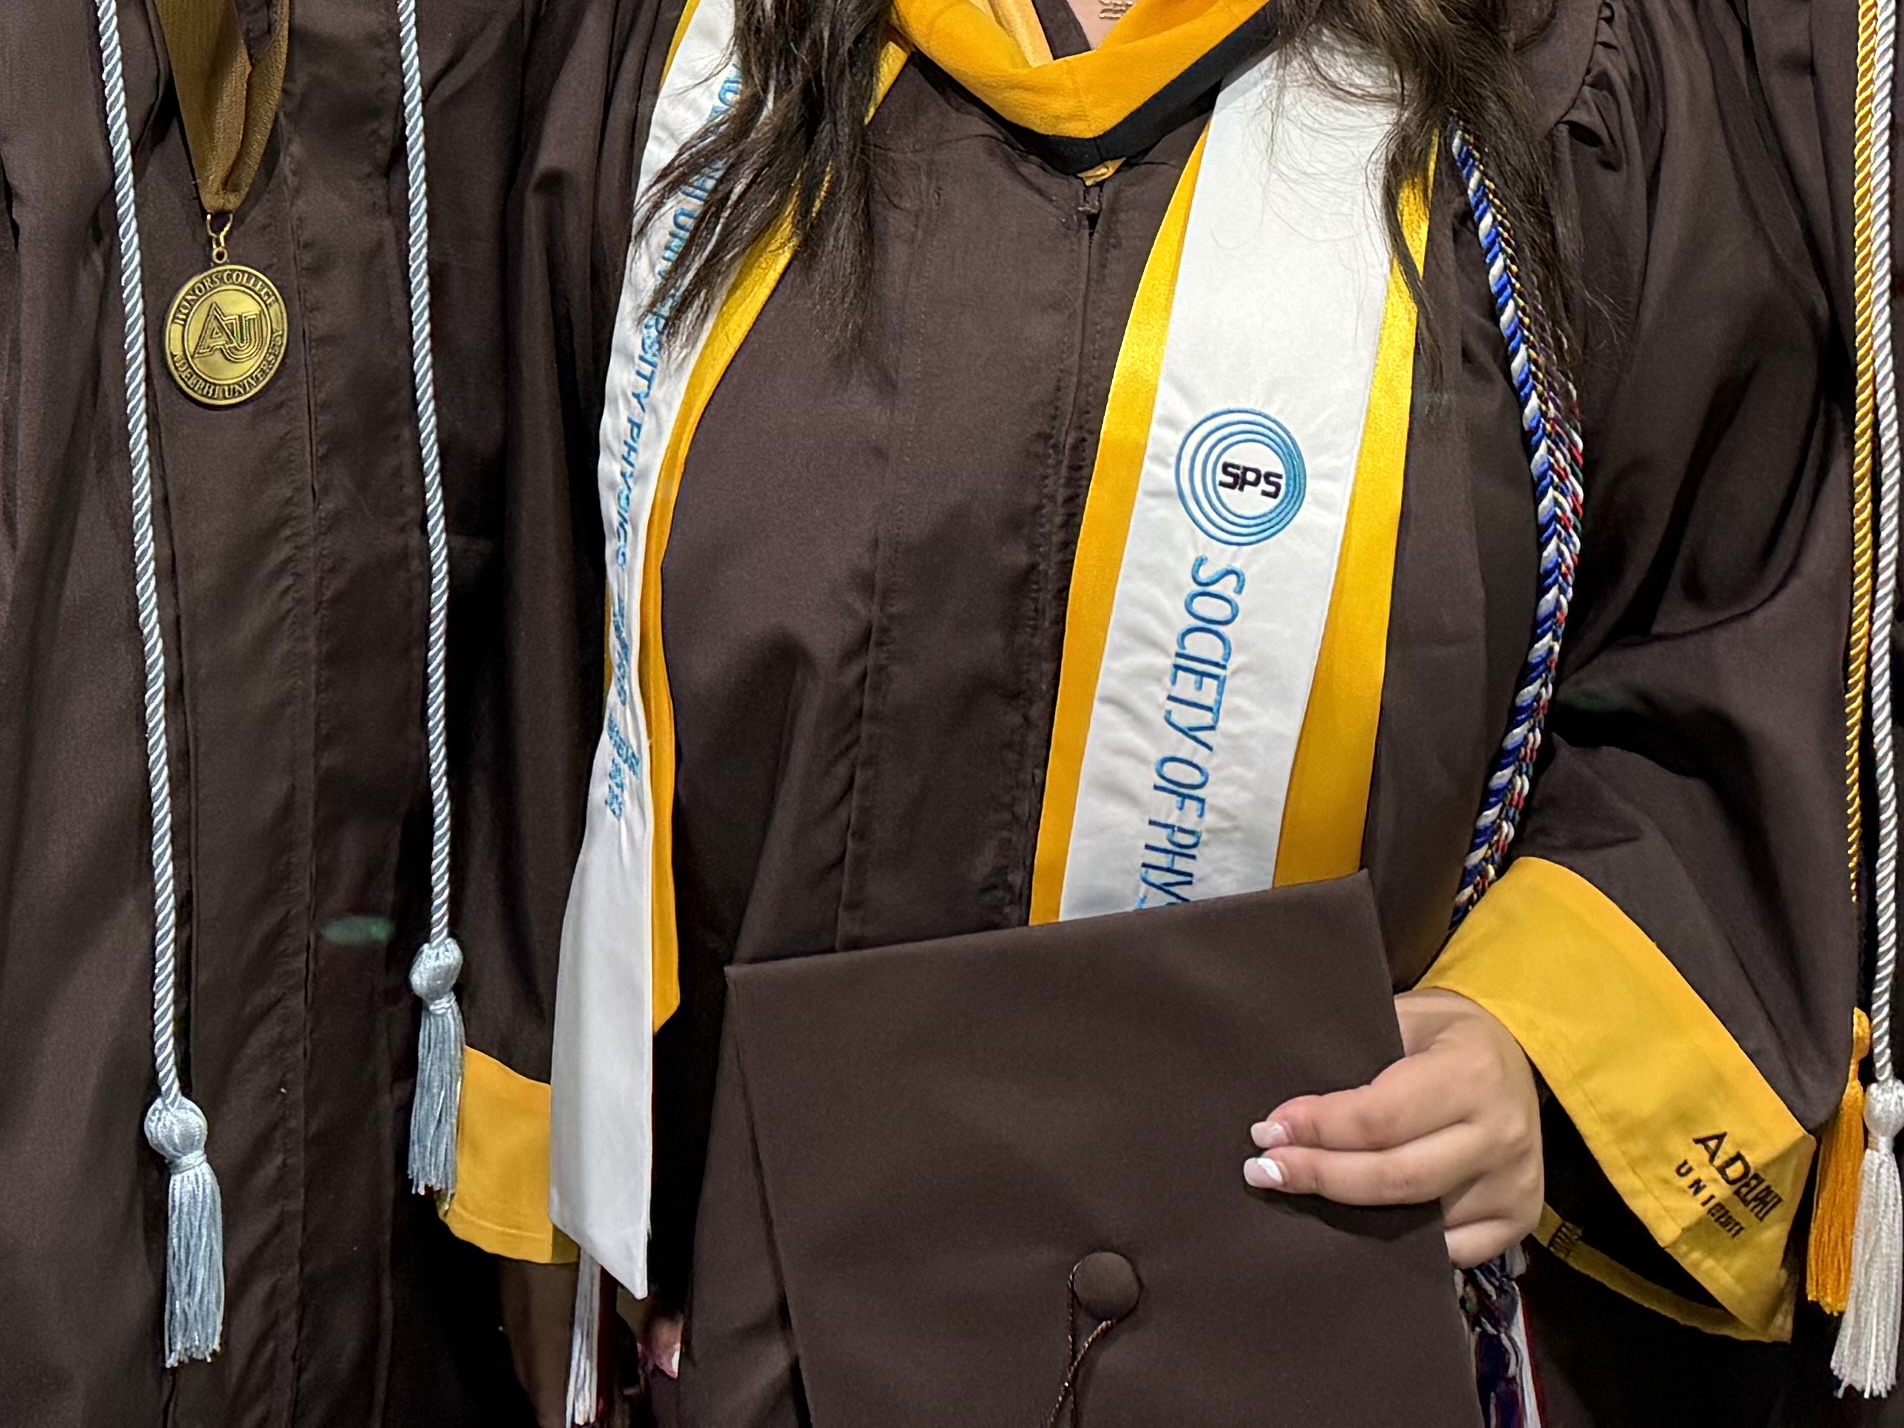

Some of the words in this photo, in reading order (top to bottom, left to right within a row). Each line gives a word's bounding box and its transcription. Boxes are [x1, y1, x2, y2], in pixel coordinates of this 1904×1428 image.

[174, 273, 221, 326] HONORS
[222, 269, 277, 308] COLLEGE
[1218, 460, 1284, 500] SPS
[1163, 554, 1246, 753] SOCIETY
[1152, 756, 1210, 819] OF
[1135, 818, 1202, 911] PHY
